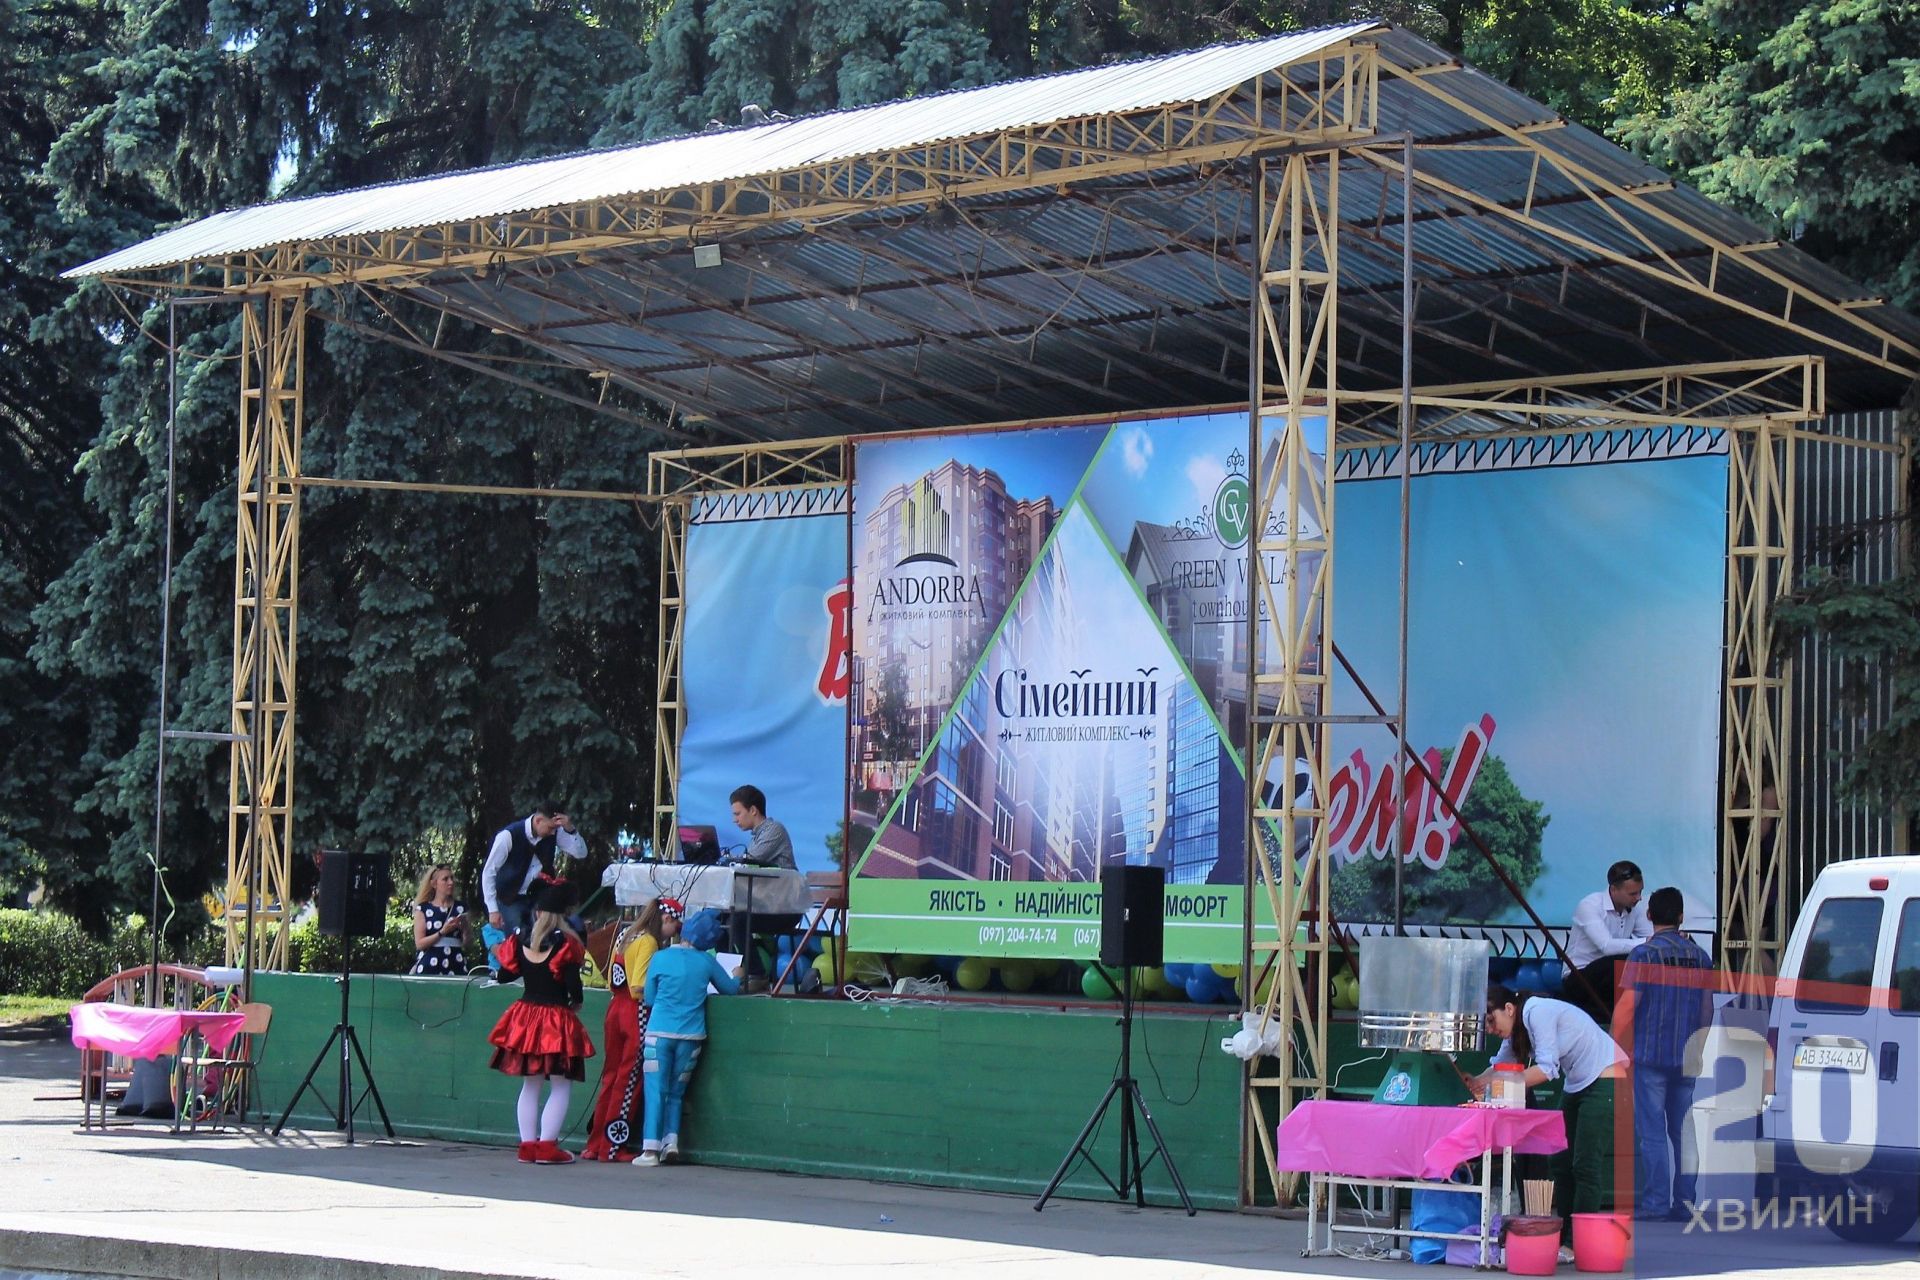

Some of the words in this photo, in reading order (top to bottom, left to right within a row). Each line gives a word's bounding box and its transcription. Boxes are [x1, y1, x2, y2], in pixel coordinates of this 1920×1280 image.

[1171, 559, 1226, 590] GREEN
[868, 575, 988, 623] ANDORRA
[1193, 595, 1270, 617] townhoue
[995, 666, 1159, 718] Сімейний
[1024, 724, 1076, 743] ЖИТЛОВИЙ
[1079, 725, 1131, 742] КОМПЛЕКС
[929, 890, 986, 912] ЯКІСТЬ
[1014, 887, 1103, 918] НАДІЙНІСТ
[1164, 894, 1229, 918] МФОРТ
[979, 926, 1005, 946] (097)
[1006, 926, 1057, 943] 204-74-74
[1073, 928, 1100, 947] (067)
[1818, 1050, 1843, 1064] 3344
